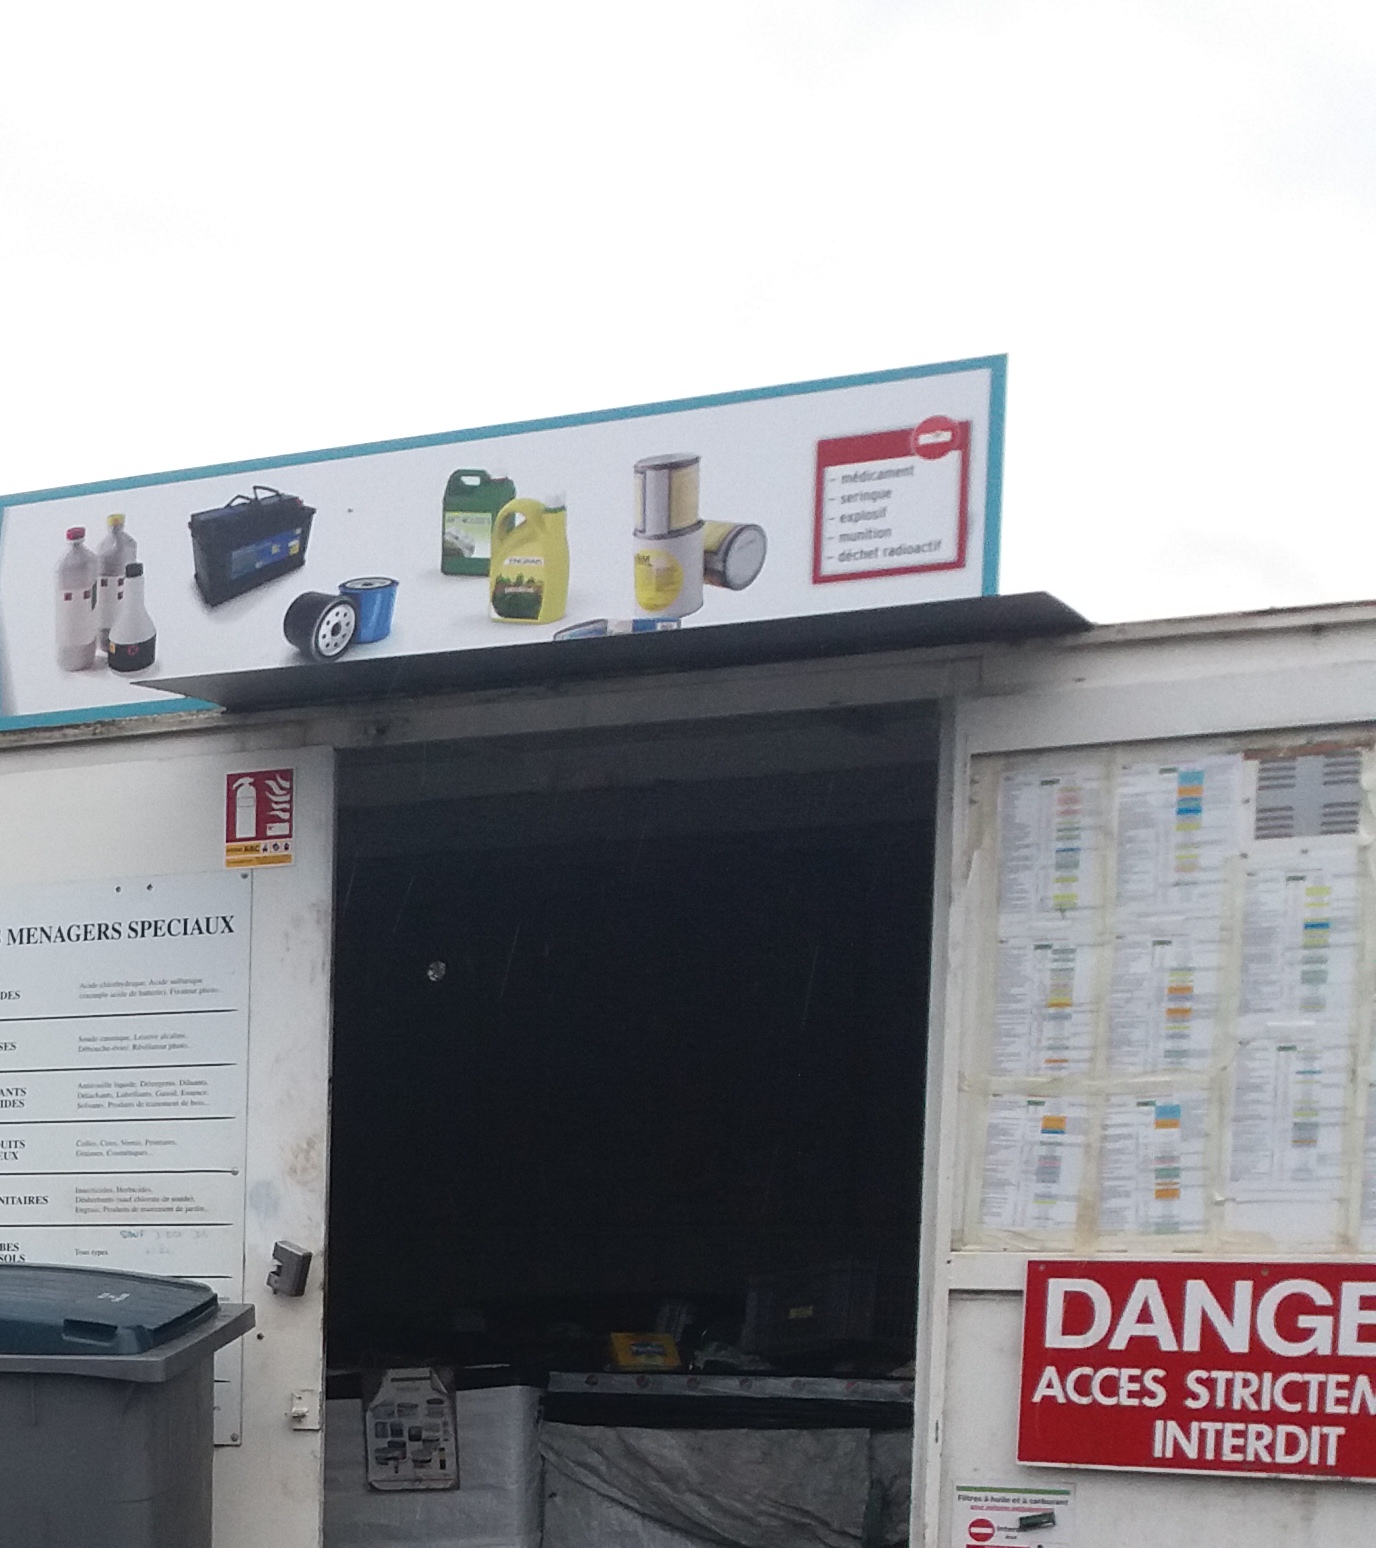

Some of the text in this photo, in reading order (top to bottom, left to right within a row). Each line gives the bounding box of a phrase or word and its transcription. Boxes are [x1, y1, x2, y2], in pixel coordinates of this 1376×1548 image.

[6, 922, 122, 947] MENAGERS
[127, 915, 235, 940] SPECIAUX
[1045, 1278, 1376, 1357] DANGE
[1032, 1366, 1167, 1407] ACCES
[1154, 1420, 1345, 1466] INTERDIT
